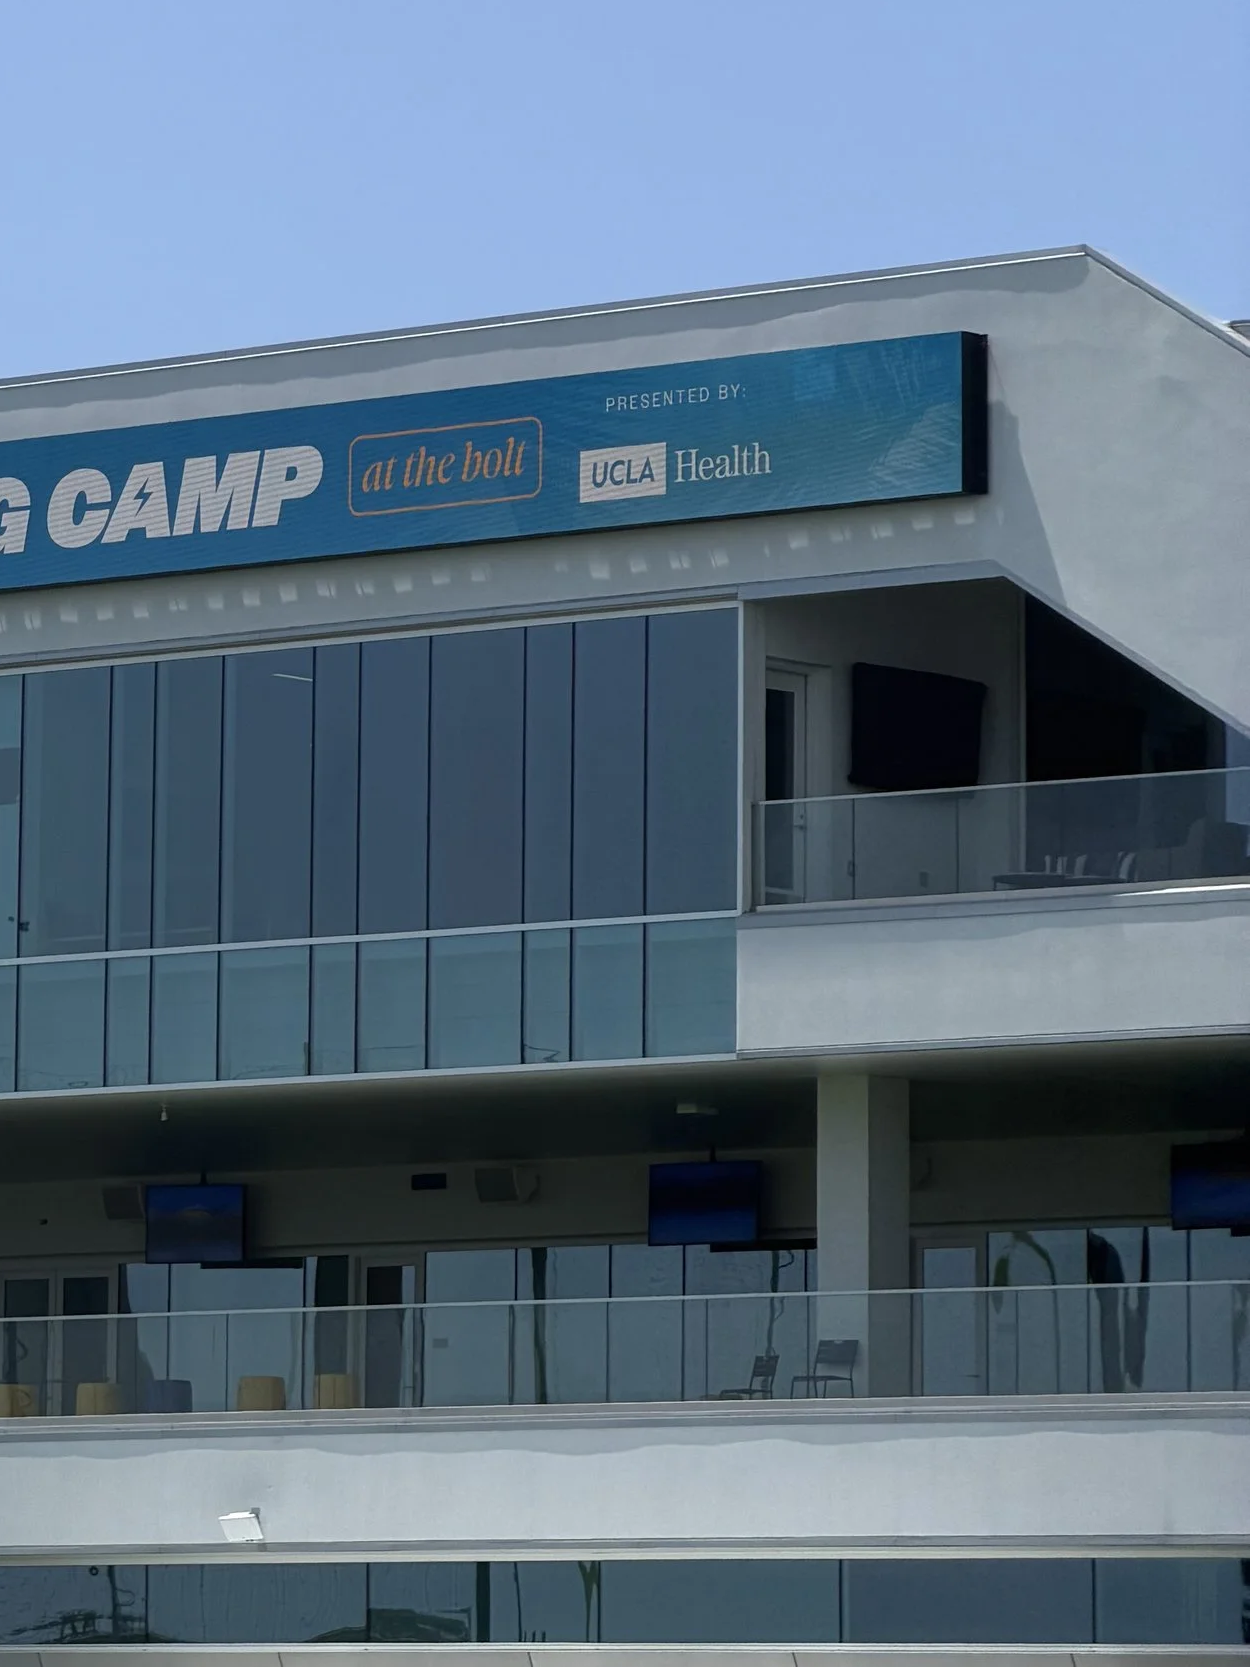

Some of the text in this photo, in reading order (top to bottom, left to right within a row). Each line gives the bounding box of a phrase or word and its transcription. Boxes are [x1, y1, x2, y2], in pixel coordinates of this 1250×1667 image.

[606, 383, 747, 412] PRESENTED BY:
[361, 437, 526, 492] at the bolt
[591, 443, 771, 488] UCLA Health
[46, 445, 324, 548] CAMP
